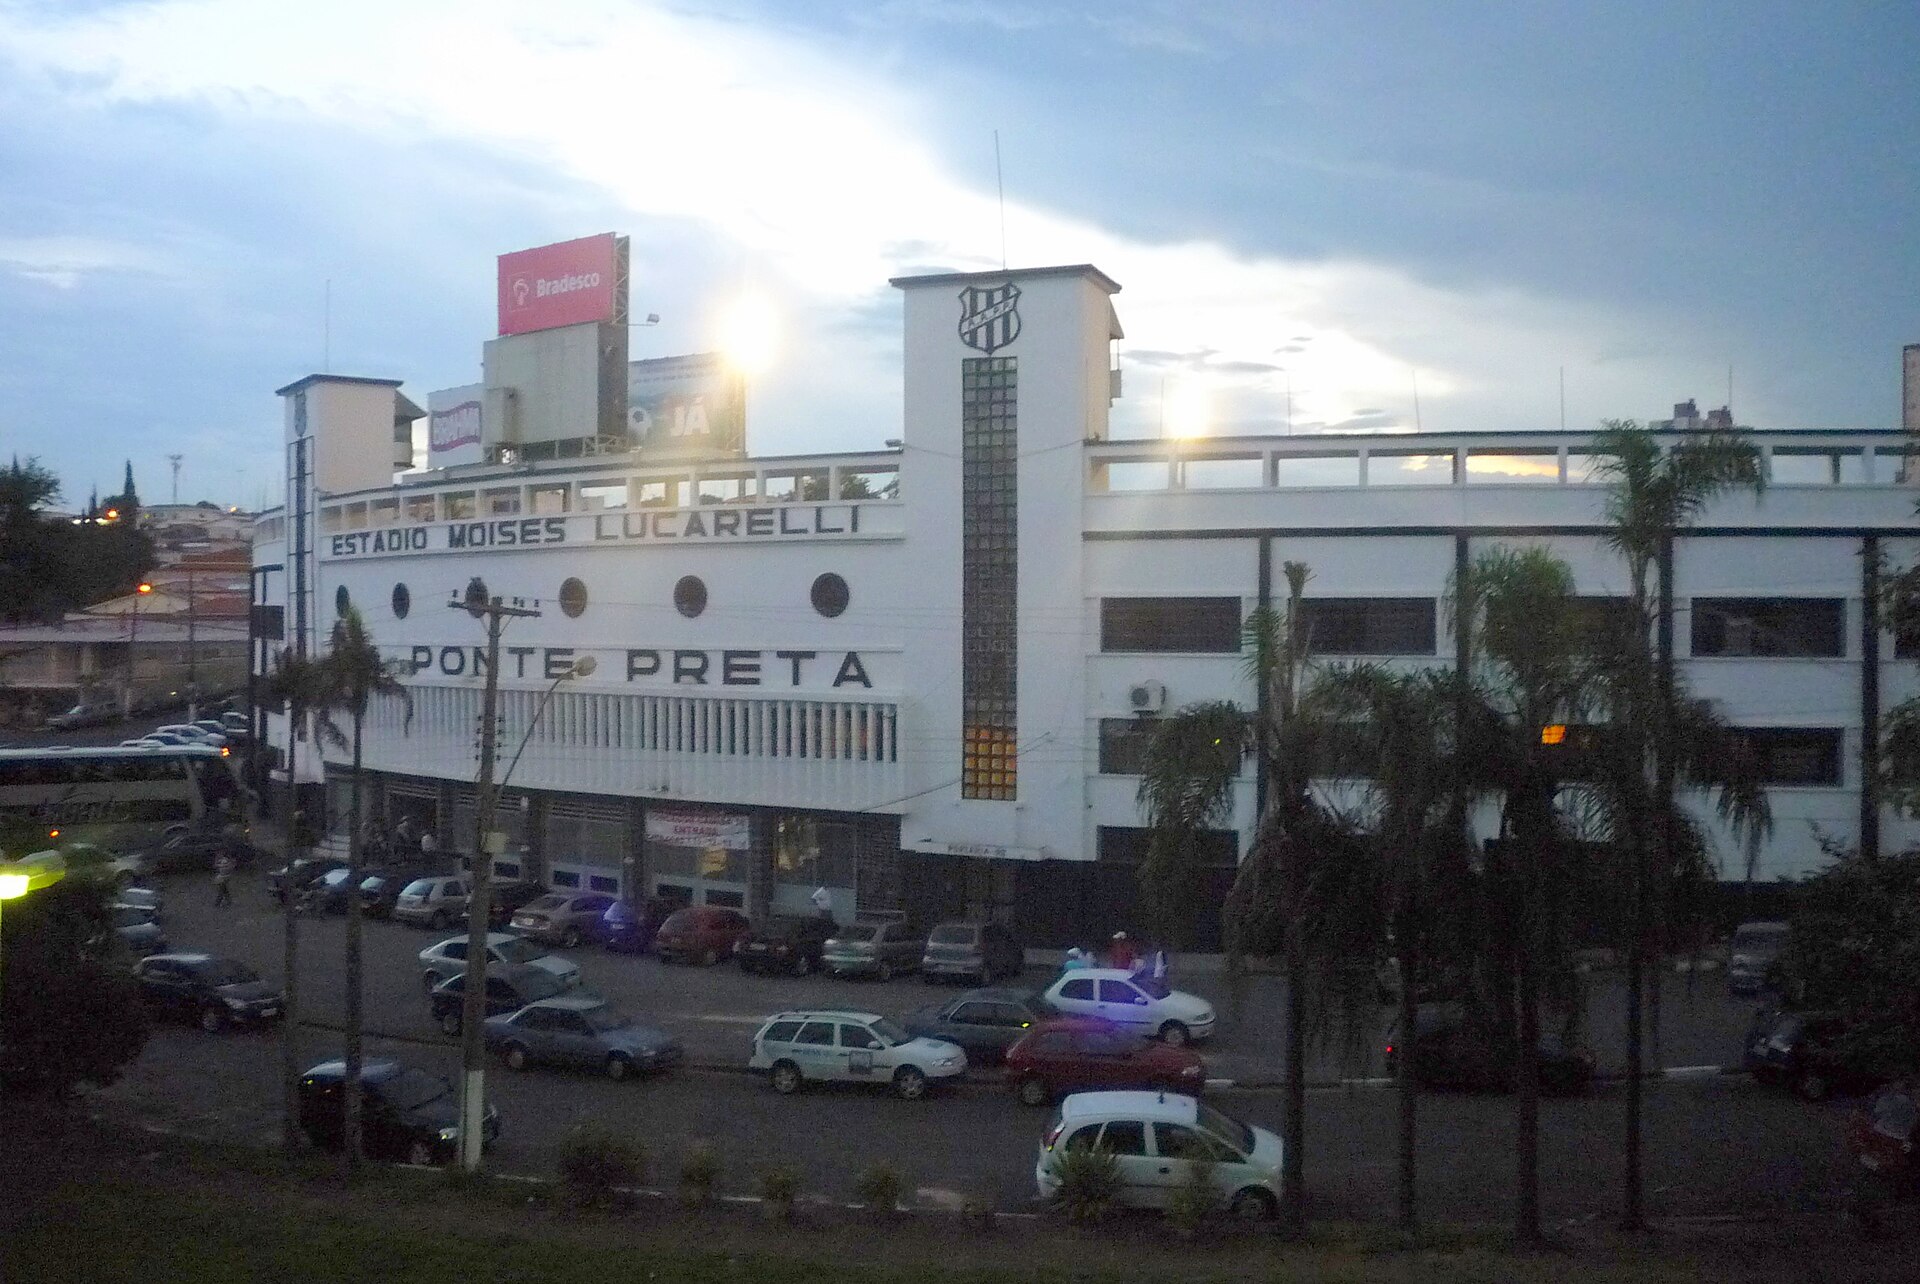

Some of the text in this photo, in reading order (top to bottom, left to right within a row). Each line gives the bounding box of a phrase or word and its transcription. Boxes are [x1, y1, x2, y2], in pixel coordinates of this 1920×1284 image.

[536, 272, 600, 298] Bradesco
[332, 504, 860, 556] ESTADIO MOISES LUCARELLI
[411, 645, 873, 688] PONTE PRETA
